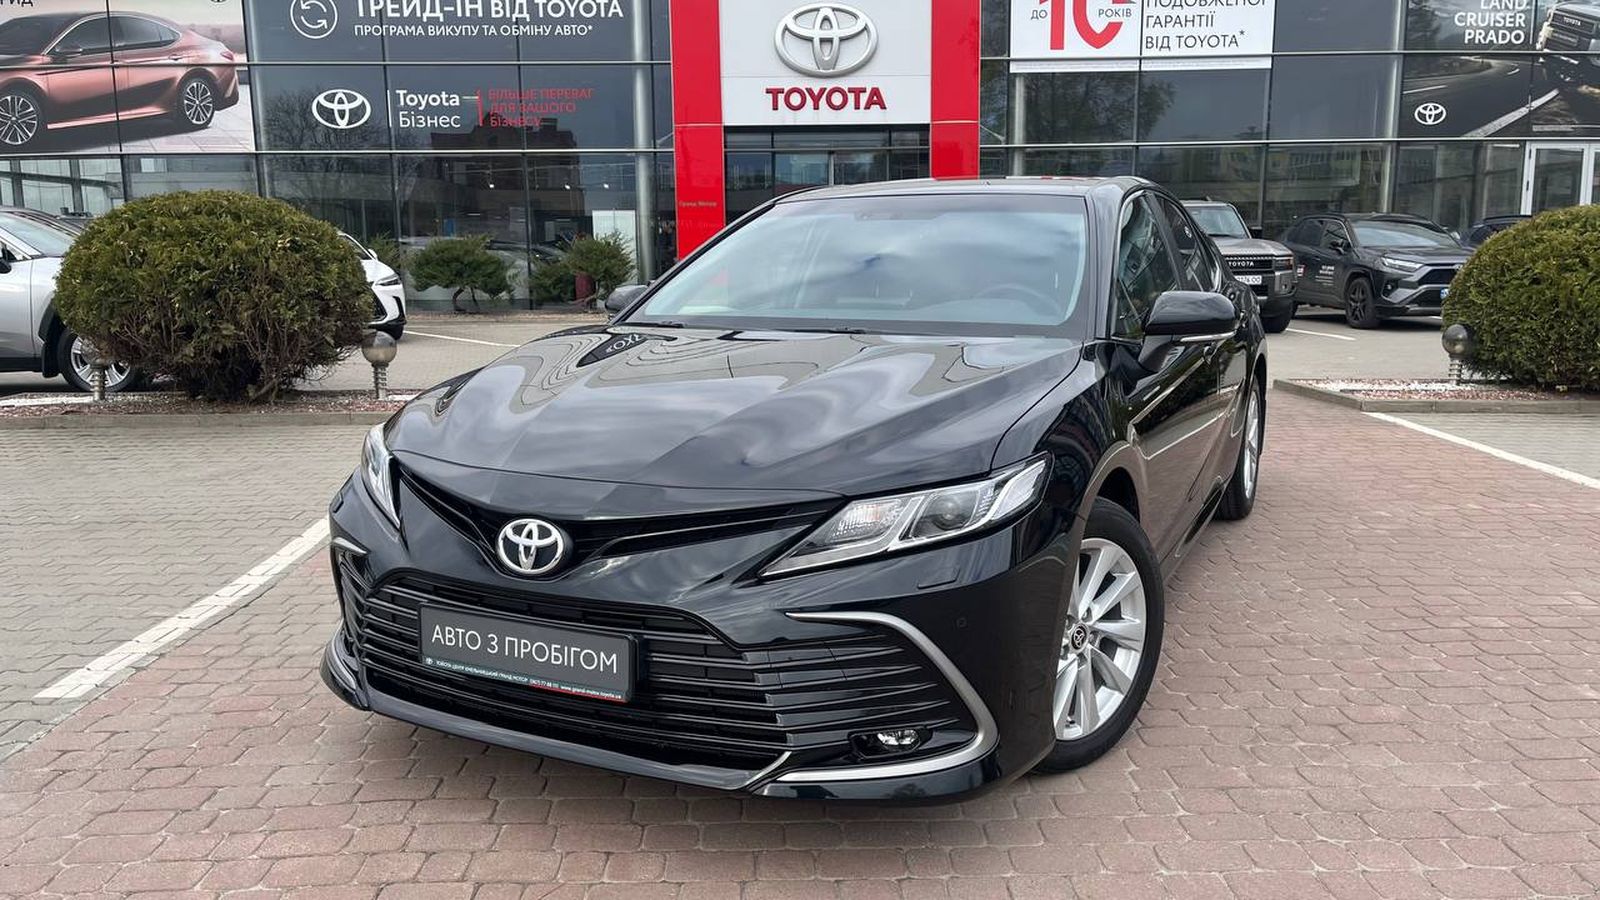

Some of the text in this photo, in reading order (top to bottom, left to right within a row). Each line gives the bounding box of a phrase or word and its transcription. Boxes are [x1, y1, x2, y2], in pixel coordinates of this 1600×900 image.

[491, 0, 530, 21] ВІД
[535, 0, 624, 18] TOYOTA
[1480, 0, 1526, 10] LAND
[1031, 10, 1048, 20] ДО
[1098, 8, 1132, 18] РОКІВ
[1146, 11, 1215, 28] ГАРАНТІЇ
[1454, 12, 1526, 27] CRUISER
[354, 25, 425, 36] ПРОГРАМА
[428, 25, 479, 36] ВИКУПУ
[482, 25, 497, 35] ТА
[500, 25, 552, 36] ОБМІНУ
[1464, 30, 1525, 44] PRADO
[1145, 36, 1171, 51] ВІД
[396, 90, 460, 110] Toyota
[765, 87, 887, 111] TOYOTA
[400, 111, 461, 128] Бізнес
[431, 624, 482, 651] АВТО
[504, 636, 618, 674] ПРОБІГОМ
